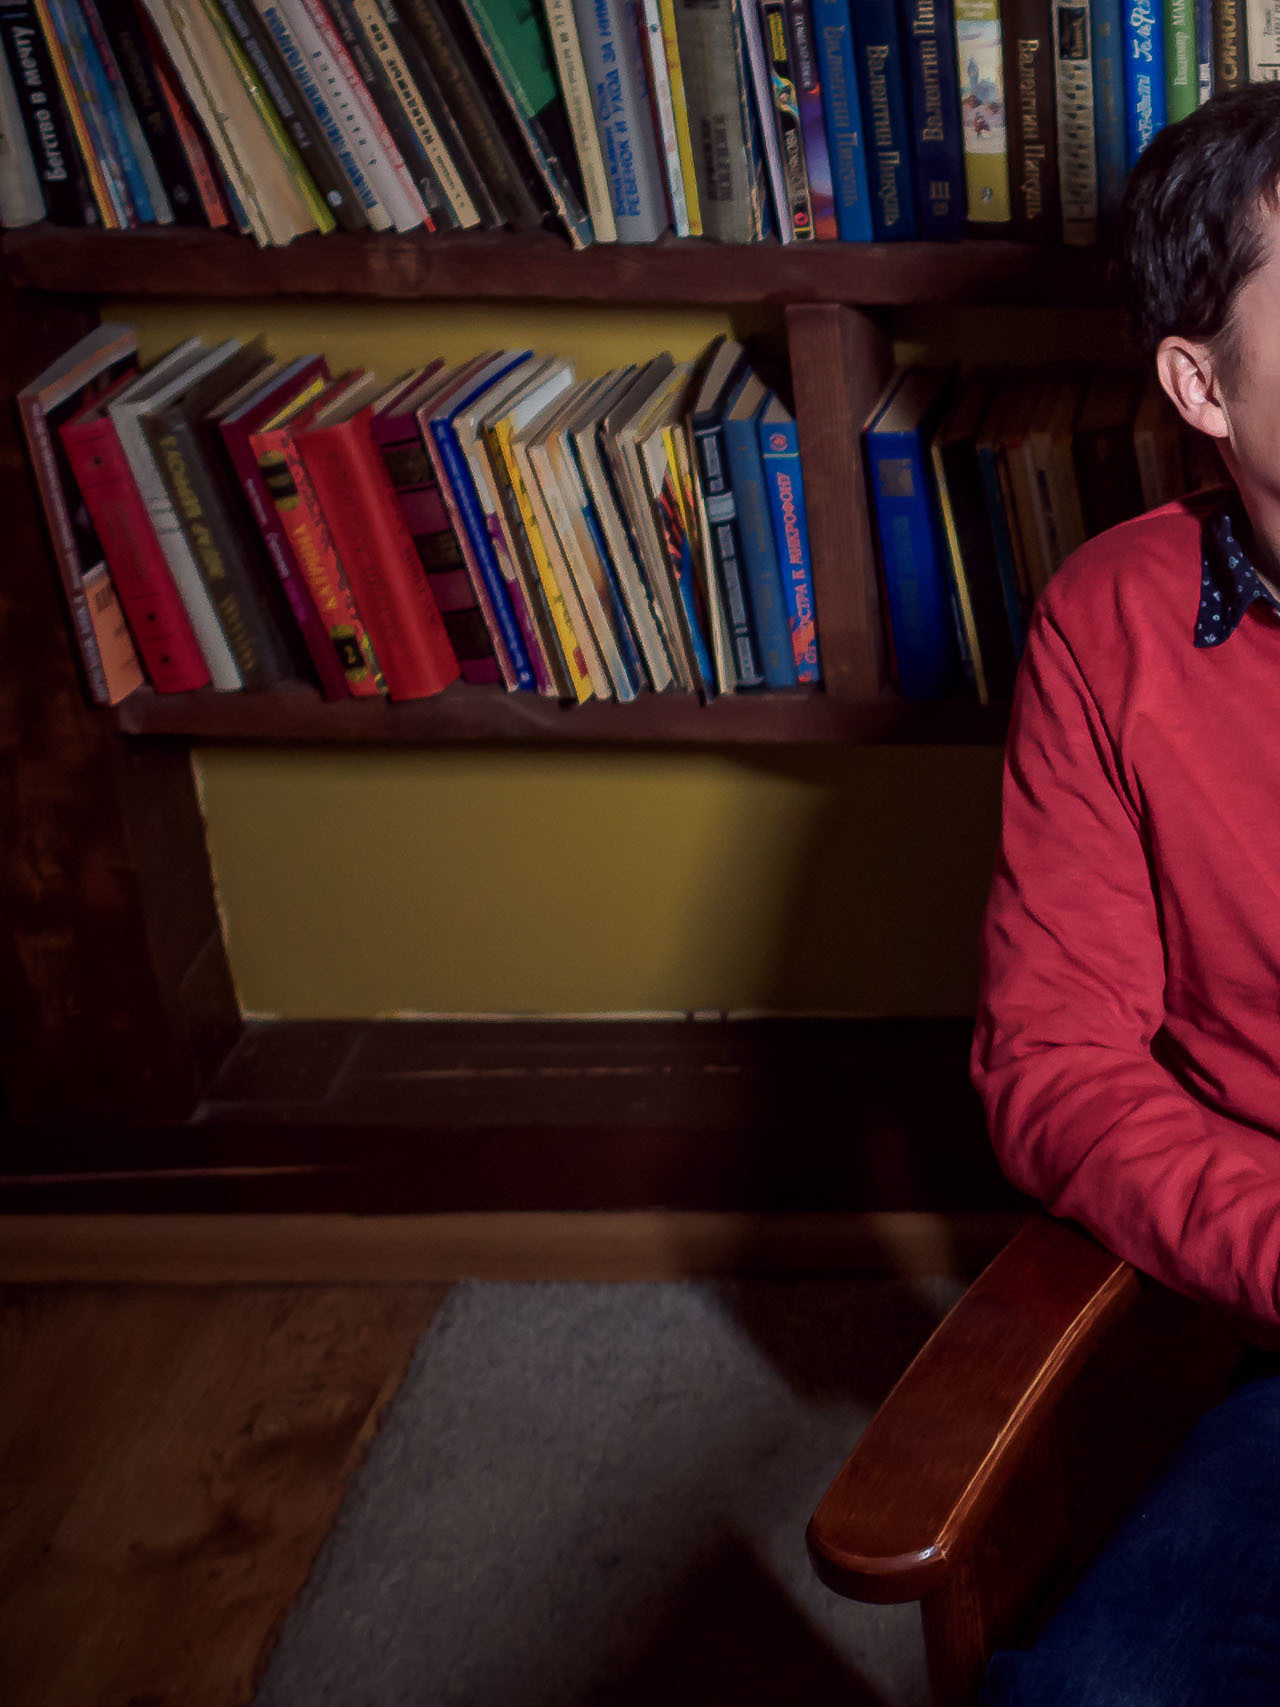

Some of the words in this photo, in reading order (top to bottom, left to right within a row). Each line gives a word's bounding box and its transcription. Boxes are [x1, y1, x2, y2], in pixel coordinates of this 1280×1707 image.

[10, 24, 43, 89] мечту
[602, 42, 618, 63] ЗА
[29, 91, 48, 105] в
[604, 68, 626, 116] УХОД
[614, 122, 630, 134] И
[822, 25, 850, 128] Валентин
[838, 131, 860, 207] Пикуль
[866, 44, 893, 147] Валентин
[920, 40, 945, 142] Валентин
[1017, 38, 1042, 146] Валентин
[34, 108, 69, 182] Бегство
[617, 140, 641, 216] РЕБЕНОК
[877, 151, 901, 228] Пикуль
[1020, 146, 1047, 222] Пикуль
[776, 471, 804, 567] МИКРОФОНУ
[789, 568, 804, 581] К
